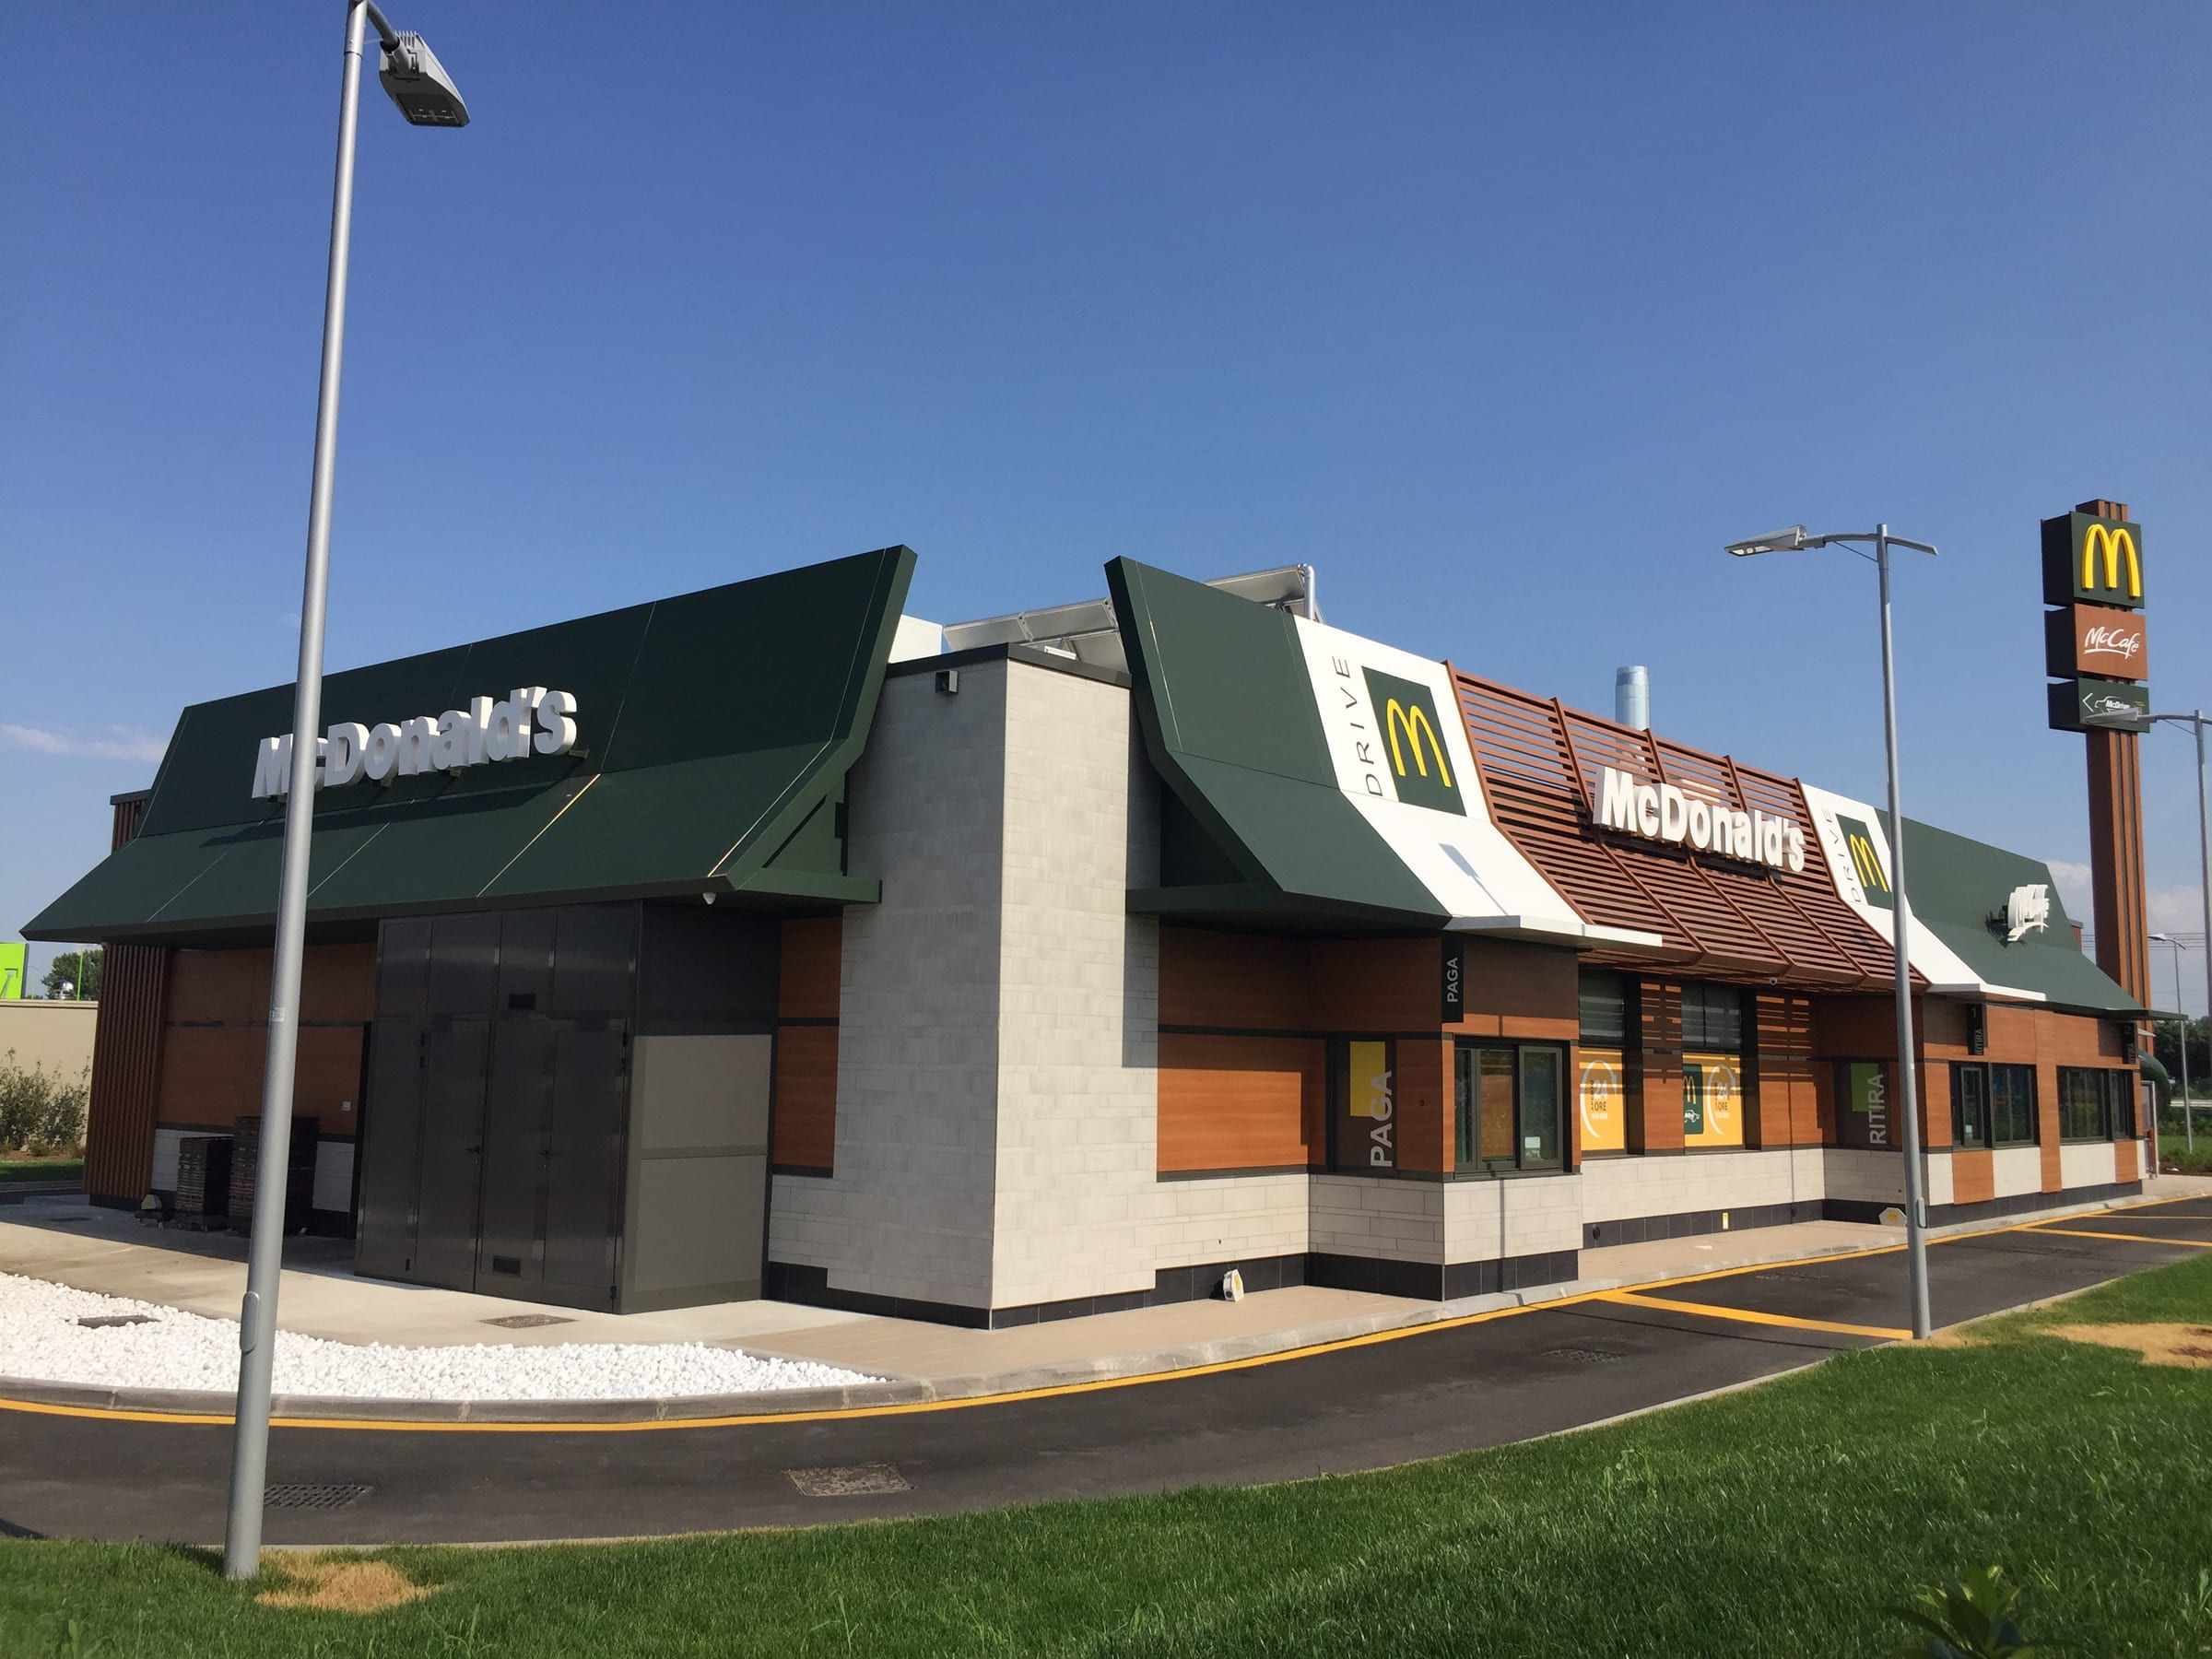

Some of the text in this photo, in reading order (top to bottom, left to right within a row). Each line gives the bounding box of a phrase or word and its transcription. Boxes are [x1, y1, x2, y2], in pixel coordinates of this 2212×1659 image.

[1332, 655, 1383, 797] DRIVE
[1593, 766, 1806, 873] McDonald's
[1821, 806, 1862, 903] DRIVE
[1446, 957, 1459, 1003] PAGA
[1370, 1070, 1394, 1168] PAGA
[1867, 1074, 1888, 1145] RITIRA
